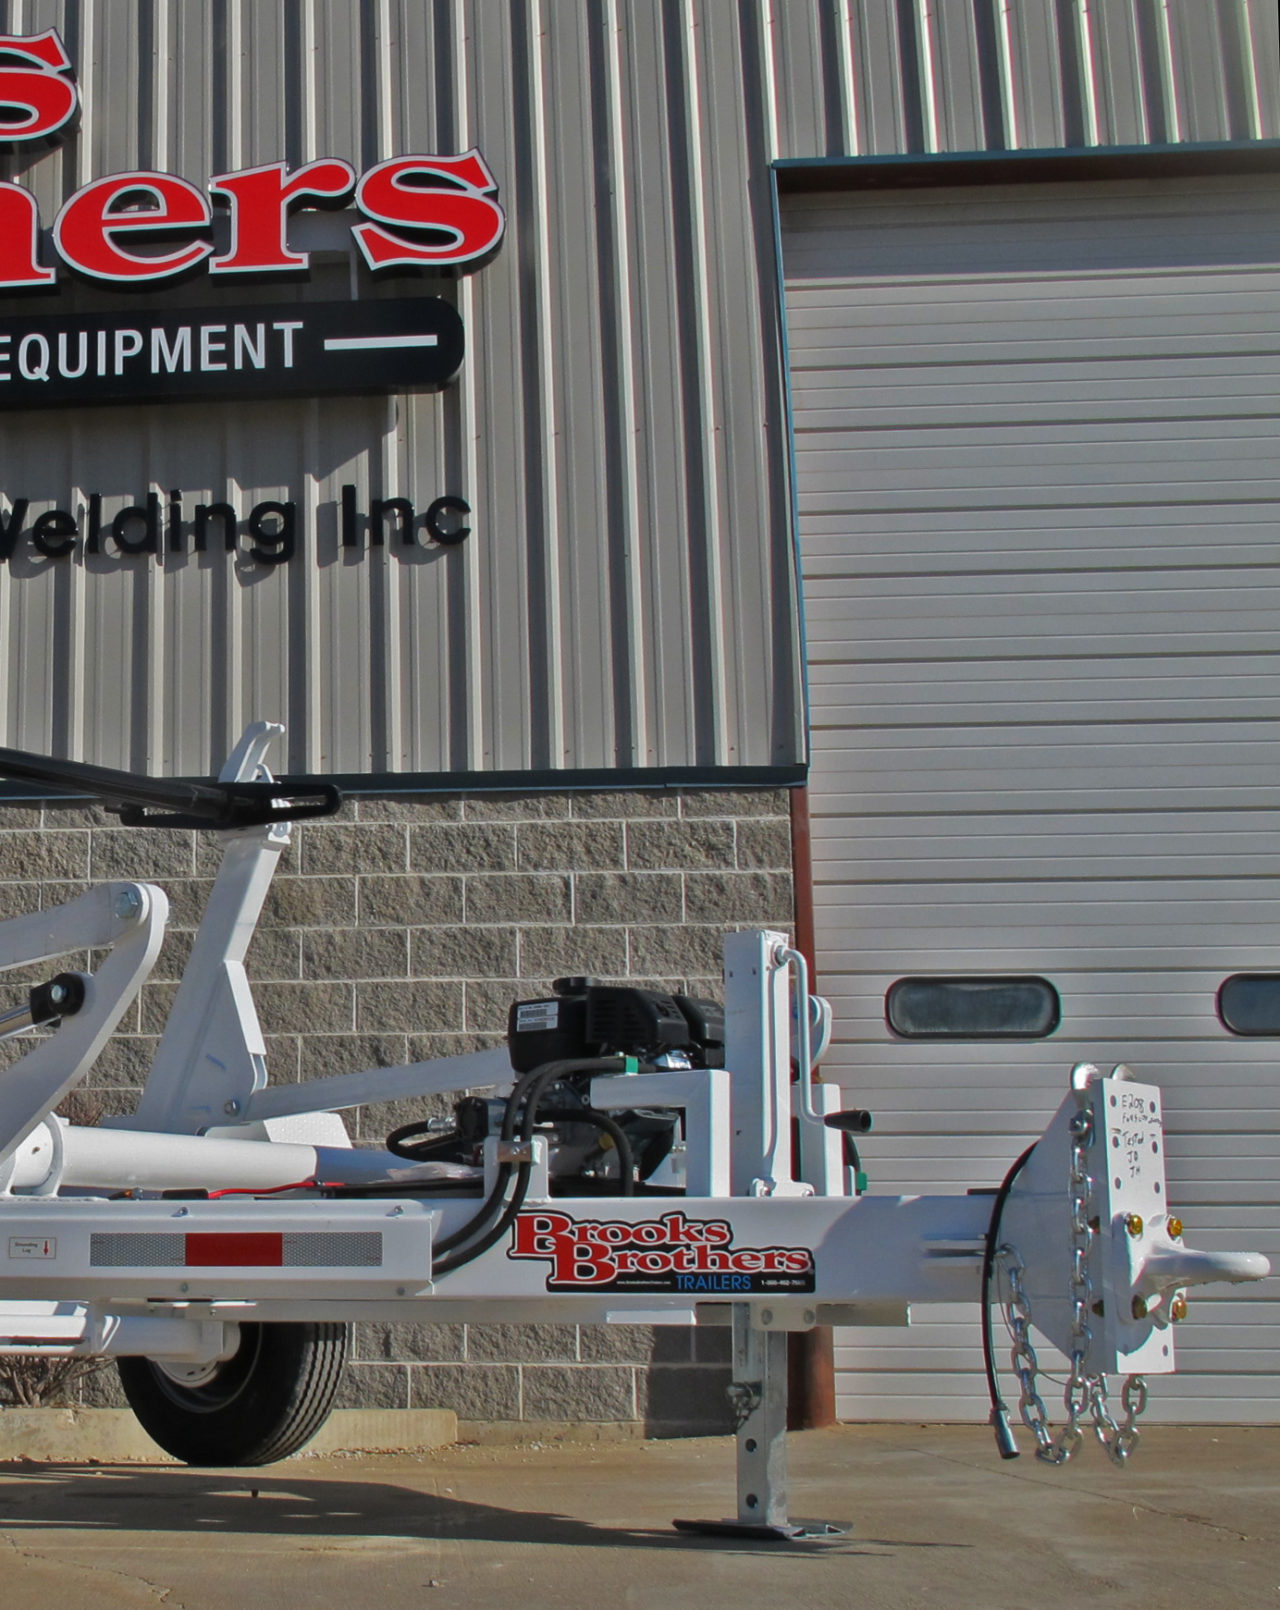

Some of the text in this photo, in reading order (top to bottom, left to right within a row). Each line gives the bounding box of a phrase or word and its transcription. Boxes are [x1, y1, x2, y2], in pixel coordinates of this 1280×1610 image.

[341, 484, 472, 548] Inc
[508, 1212, 731, 1257] Brooks
[548, 1240, 812, 1285] Brothers
[676, 1274, 752, 1291] TRAILERS
